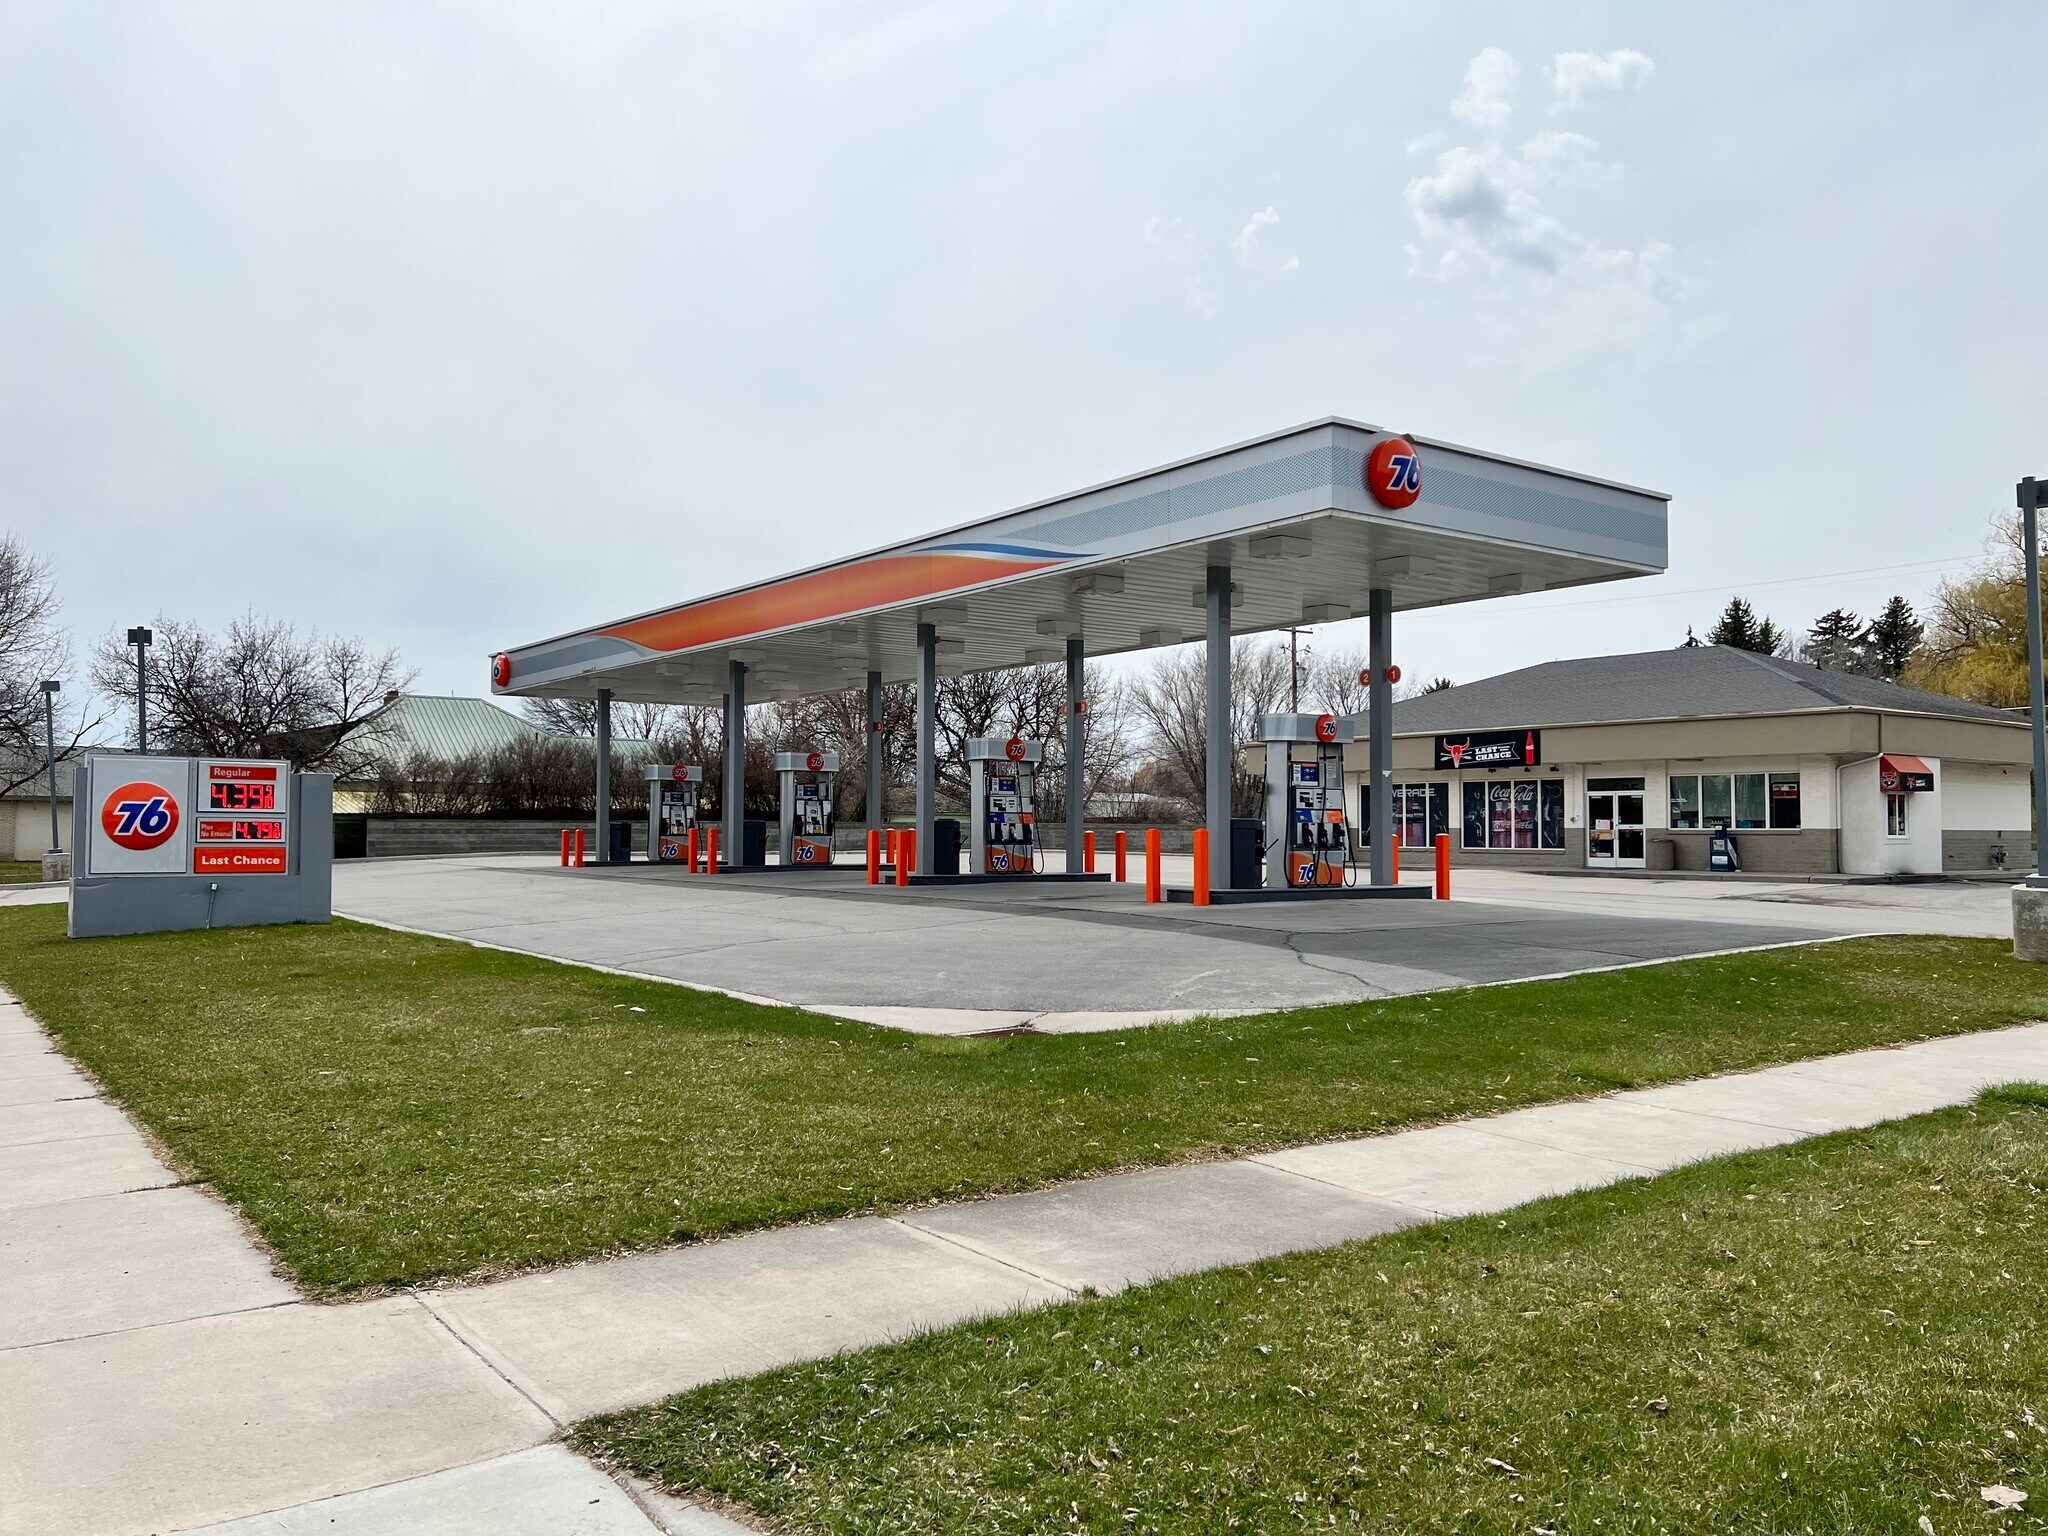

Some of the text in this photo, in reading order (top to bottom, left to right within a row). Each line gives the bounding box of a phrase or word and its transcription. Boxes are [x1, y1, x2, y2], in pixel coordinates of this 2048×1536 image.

[1386, 453, 1421, 493] 76
[1363, 673, 1369, 682] 2
[1391, 670, 1396, 680] 1
[1322, 721, 1336, 736] 76
[1011, 744, 1024, 756] 76
[1475, 746, 1498, 755] LAST
[1475, 751, 1512, 761] CHANCE
[811, 756, 823, 767] 76
[213, 767, 251, 778] Regular
[675, 767, 686, 778] 76
[211, 783, 264, 809] 4.39
[1489, 783, 1536, 802] CocaCola
[113, 796, 170, 837] 76
[236, 822, 273, 839] 4.79
[661, 843, 679, 858] 76
[796, 844, 815, 861] 76
[201, 855, 281, 865] Last Chance
[992, 854, 1009, 870] 76
[1298, 862, 1316, 883] 76
